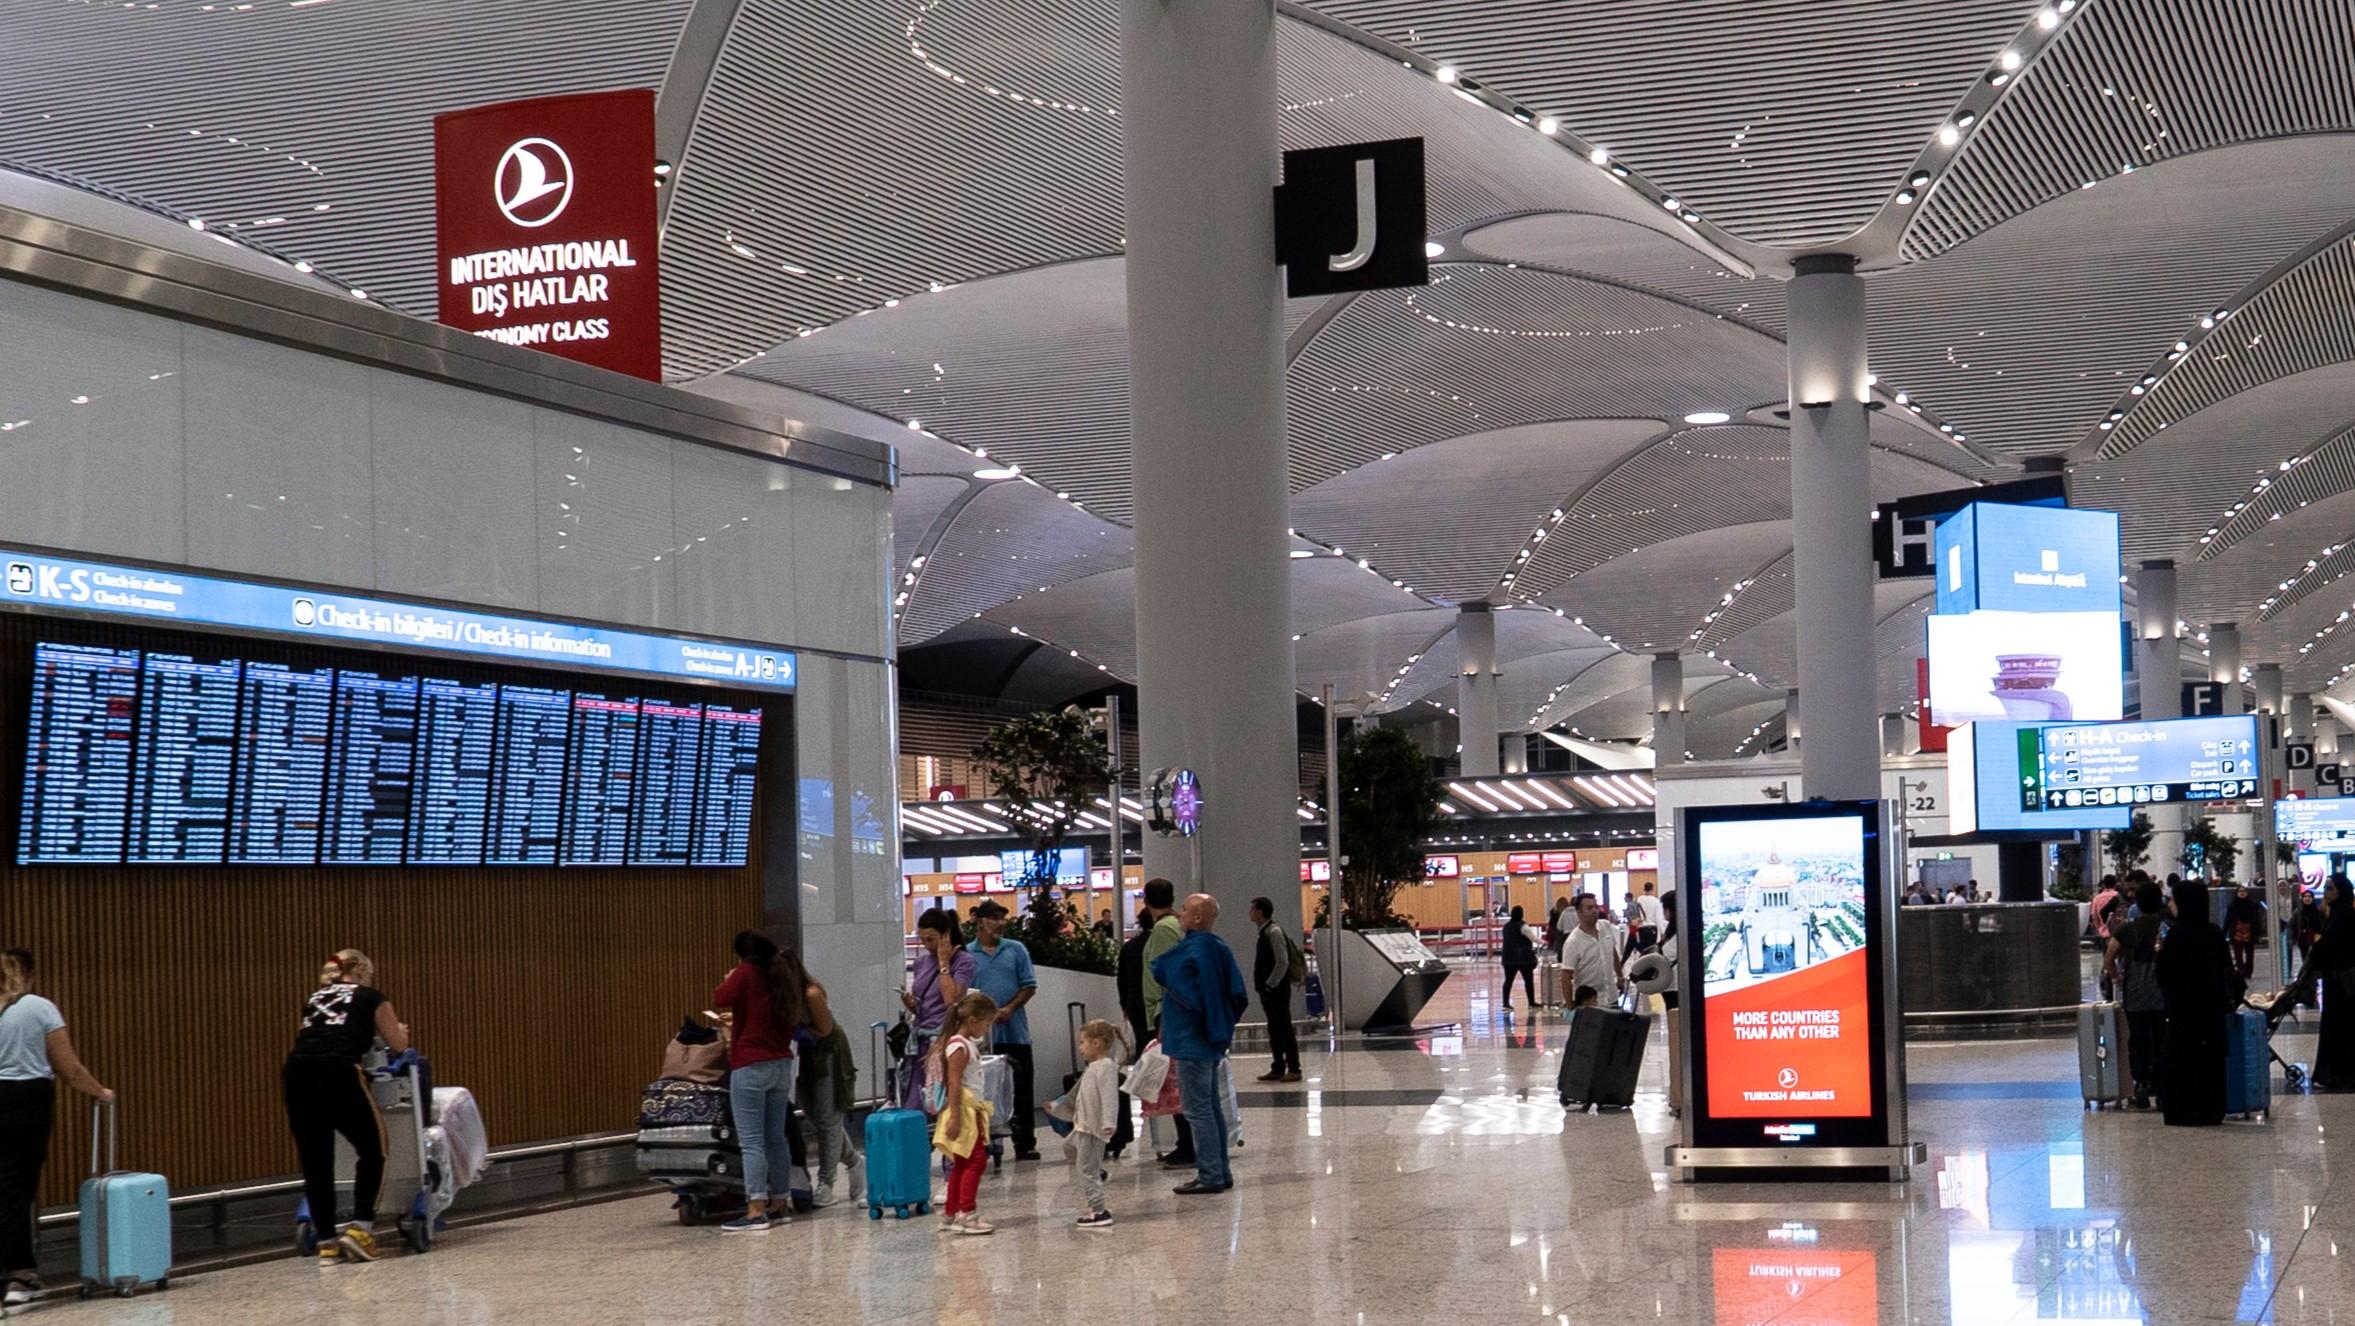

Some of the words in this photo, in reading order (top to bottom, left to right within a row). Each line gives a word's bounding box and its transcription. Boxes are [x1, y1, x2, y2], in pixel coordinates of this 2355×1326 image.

[1329, 159, 1376, 271] J
[451, 239, 636, 285] INTERNATIONAL
[472, 284, 508, 317] DIŞ
[514, 274, 608, 308] HATLAR
[473, 323, 550, 346] ONOMY
[552, 318, 610, 342] CLASS
[1892, 512, 1936, 567] H
[38, 565, 90, 602] K-S
[318, 605, 390, 632] Check-in
[394, 613, 453, 641] bilgileri
[464, 622, 529, 648] Check-in
[531, 631, 611, 658] information
[735, 653, 760, 677] A-J
[2194, 686, 2211, 715] F
[2080, 728, 2112, 745] H-A
[2116, 730, 2167, 743] Check-in
[2292, 747, 2309, 766] D
[2322, 766, 2335, 783] C
[2344, 779, 2354, 794] B
[1733, 1011, 1768, 1025] MORE
[1771, 1010, 1839, 1024] COUNTRIES
[1734, 1026, 1767, 1039] THAN
[1770, 1026, 1796, 1039] ANY
[1799, 1025, 1839, 1038] OTHER
[1743, 1091, 1787, 1100] TURKISH
[1790, 1090, 1835, 1100] AIRLINES
